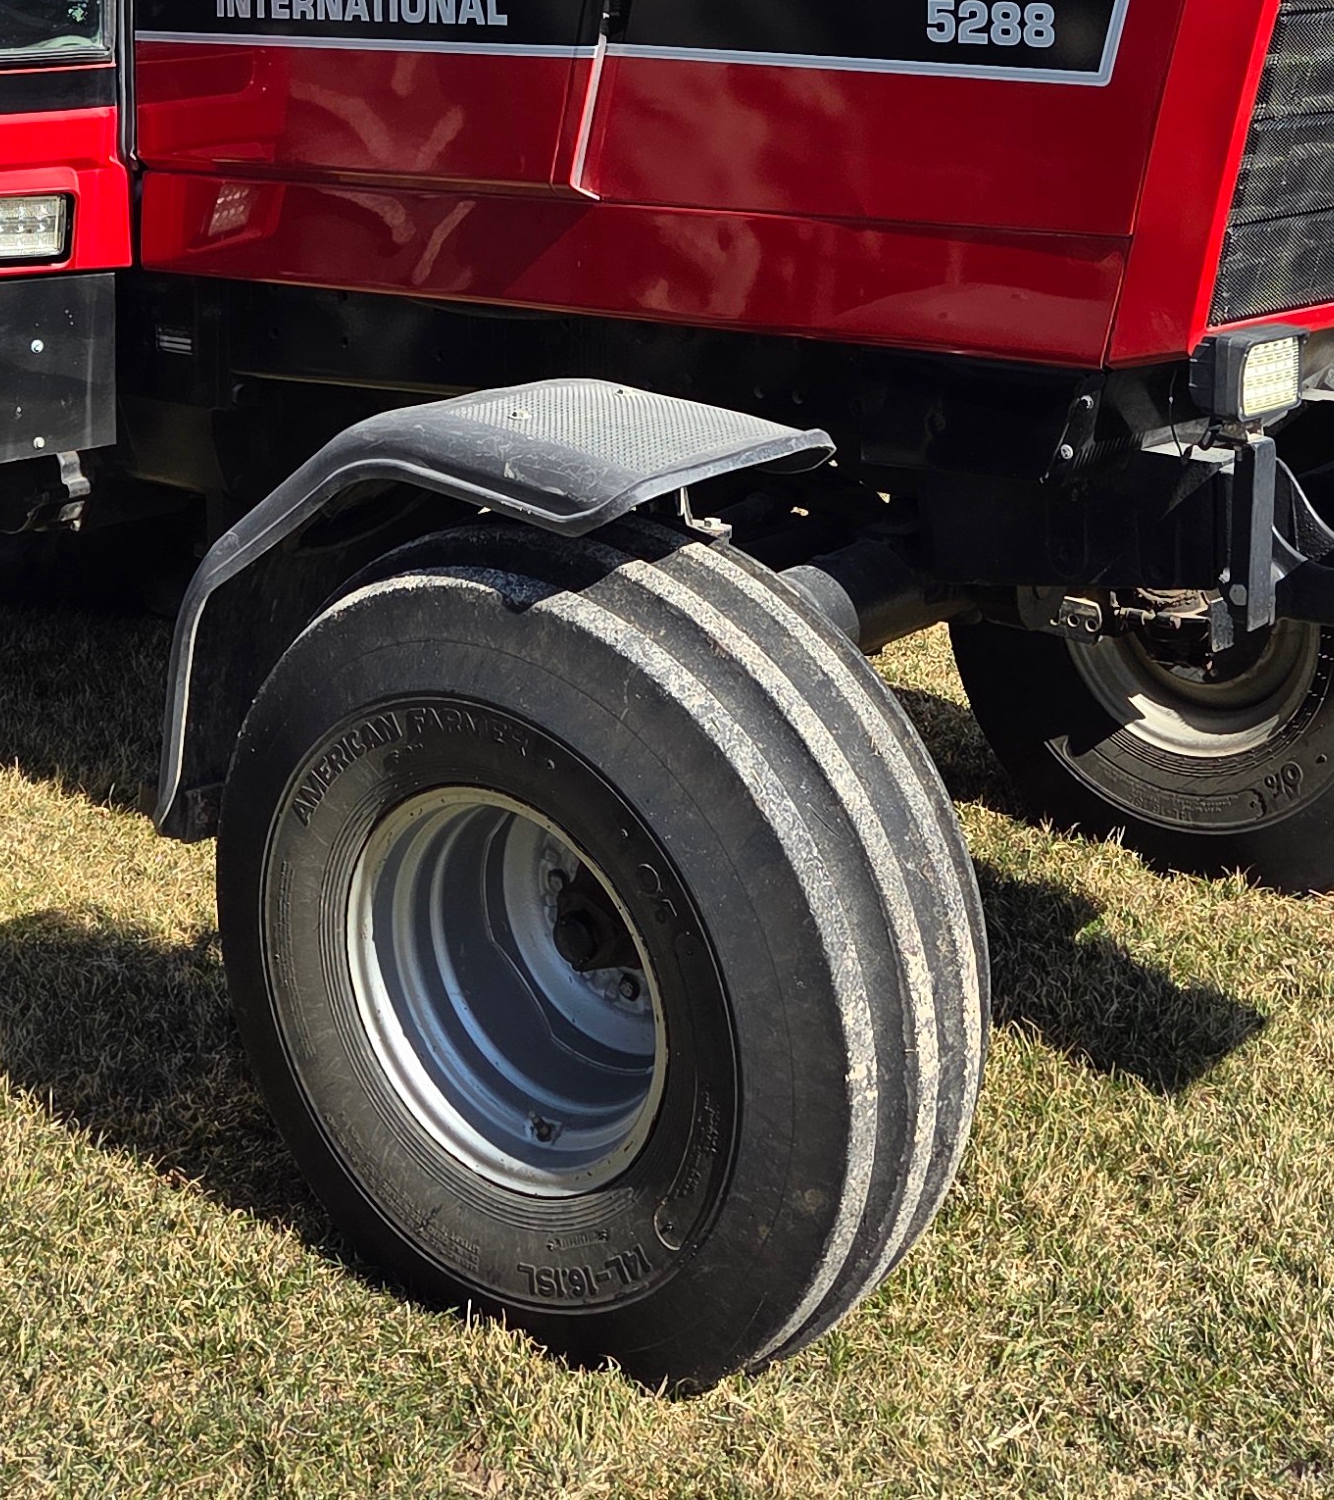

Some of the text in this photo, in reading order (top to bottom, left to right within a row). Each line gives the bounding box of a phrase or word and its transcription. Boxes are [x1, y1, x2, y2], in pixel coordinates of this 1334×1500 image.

[290, 707, 531, 828] AMERICAN FARMER
[516, 1243, 652, 1300] 14L-16.1SL
